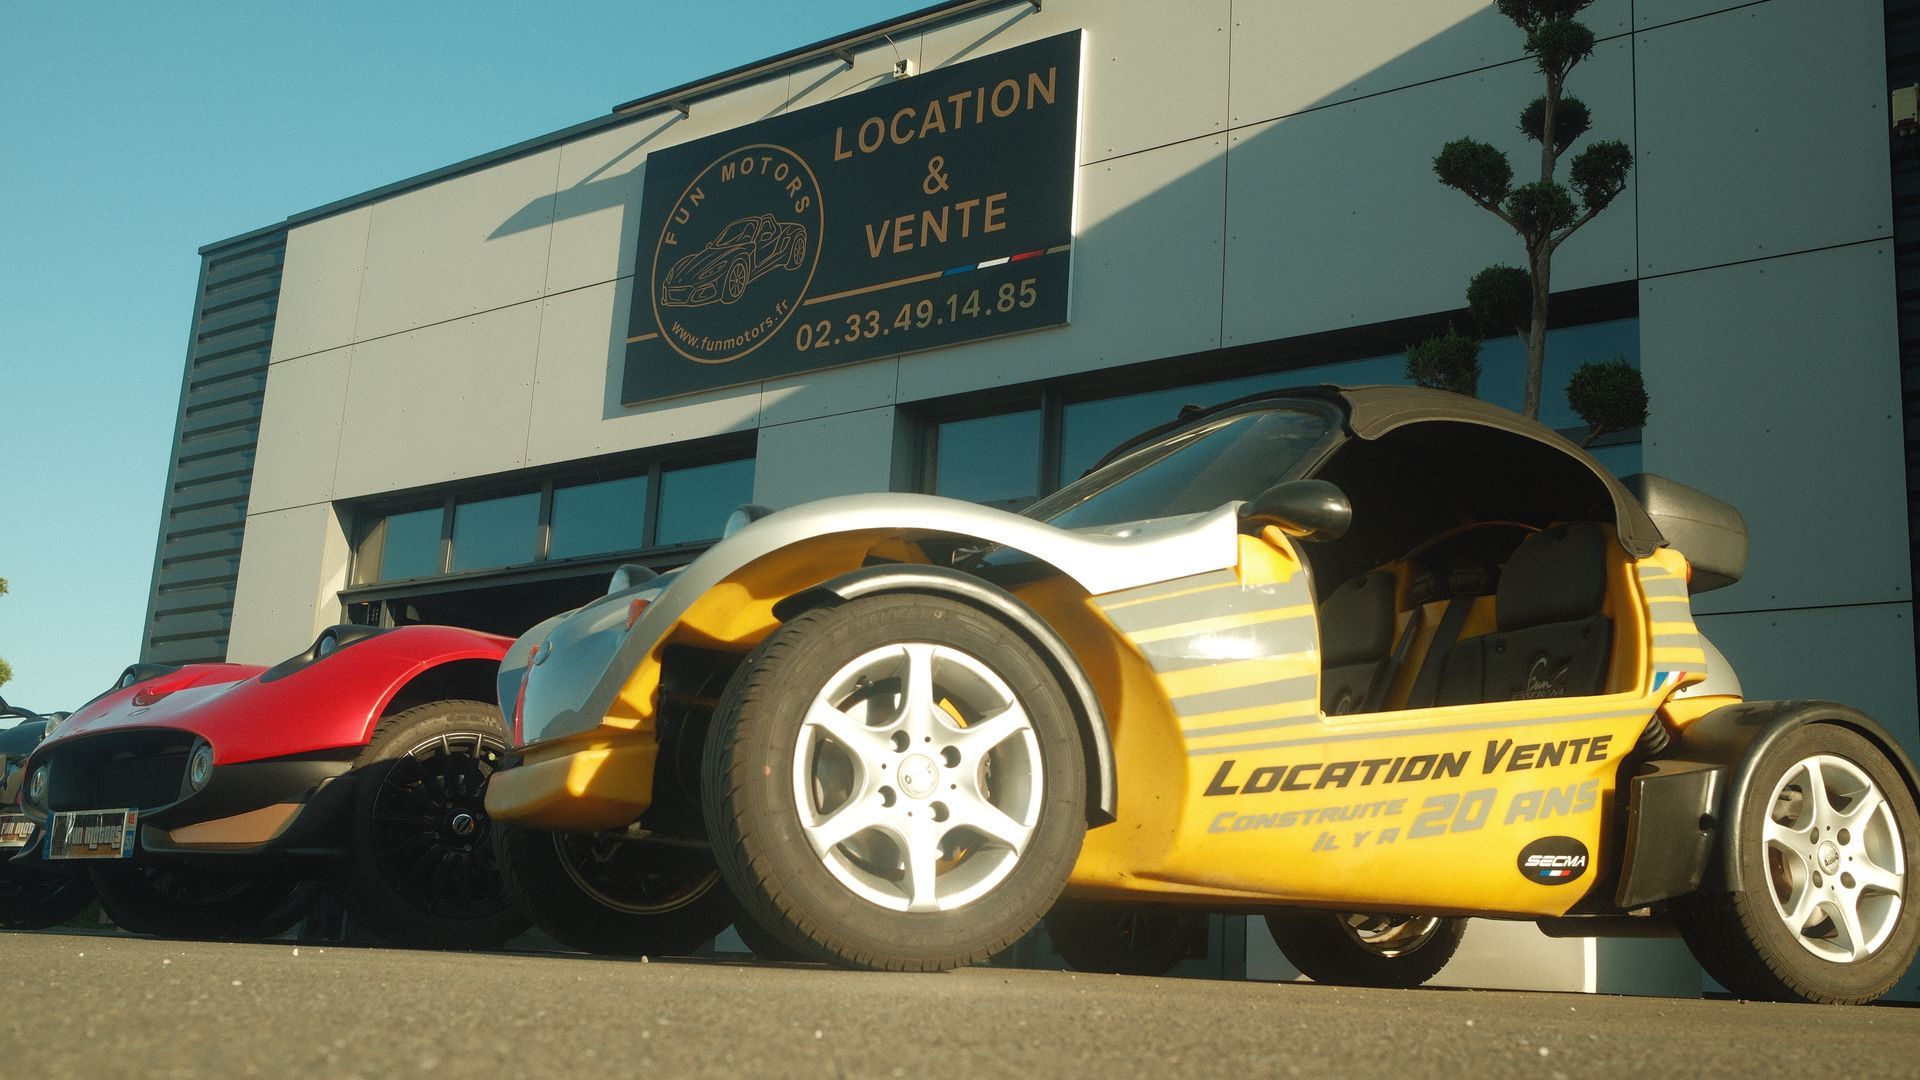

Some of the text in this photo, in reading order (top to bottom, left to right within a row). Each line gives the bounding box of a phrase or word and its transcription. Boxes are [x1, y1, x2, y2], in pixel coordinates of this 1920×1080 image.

[833, 66, 1057, 161] LOCATION
[665, 156, 810, 245] FUN MOTORS
[922, 155, 950, 194] &
[864, 191, 1008, 259] VENTE
[671, 299, 789, 351] www.funmotors.fr
[795, 278, 1038, 352] 02.33.49.14.85
[1203, 735, 1613, 797] LOCATION VENTE
[1207, 798, 1409, 835] CONSTRUITE
[1353, 830, 1369, 848] Y
[1376, 828, 1400, 846] A
[1407, 788, 1498, 840] 20
[1503, 778, 1601, 826] ANS
[1524, 854, 1586, 867] SECMA
